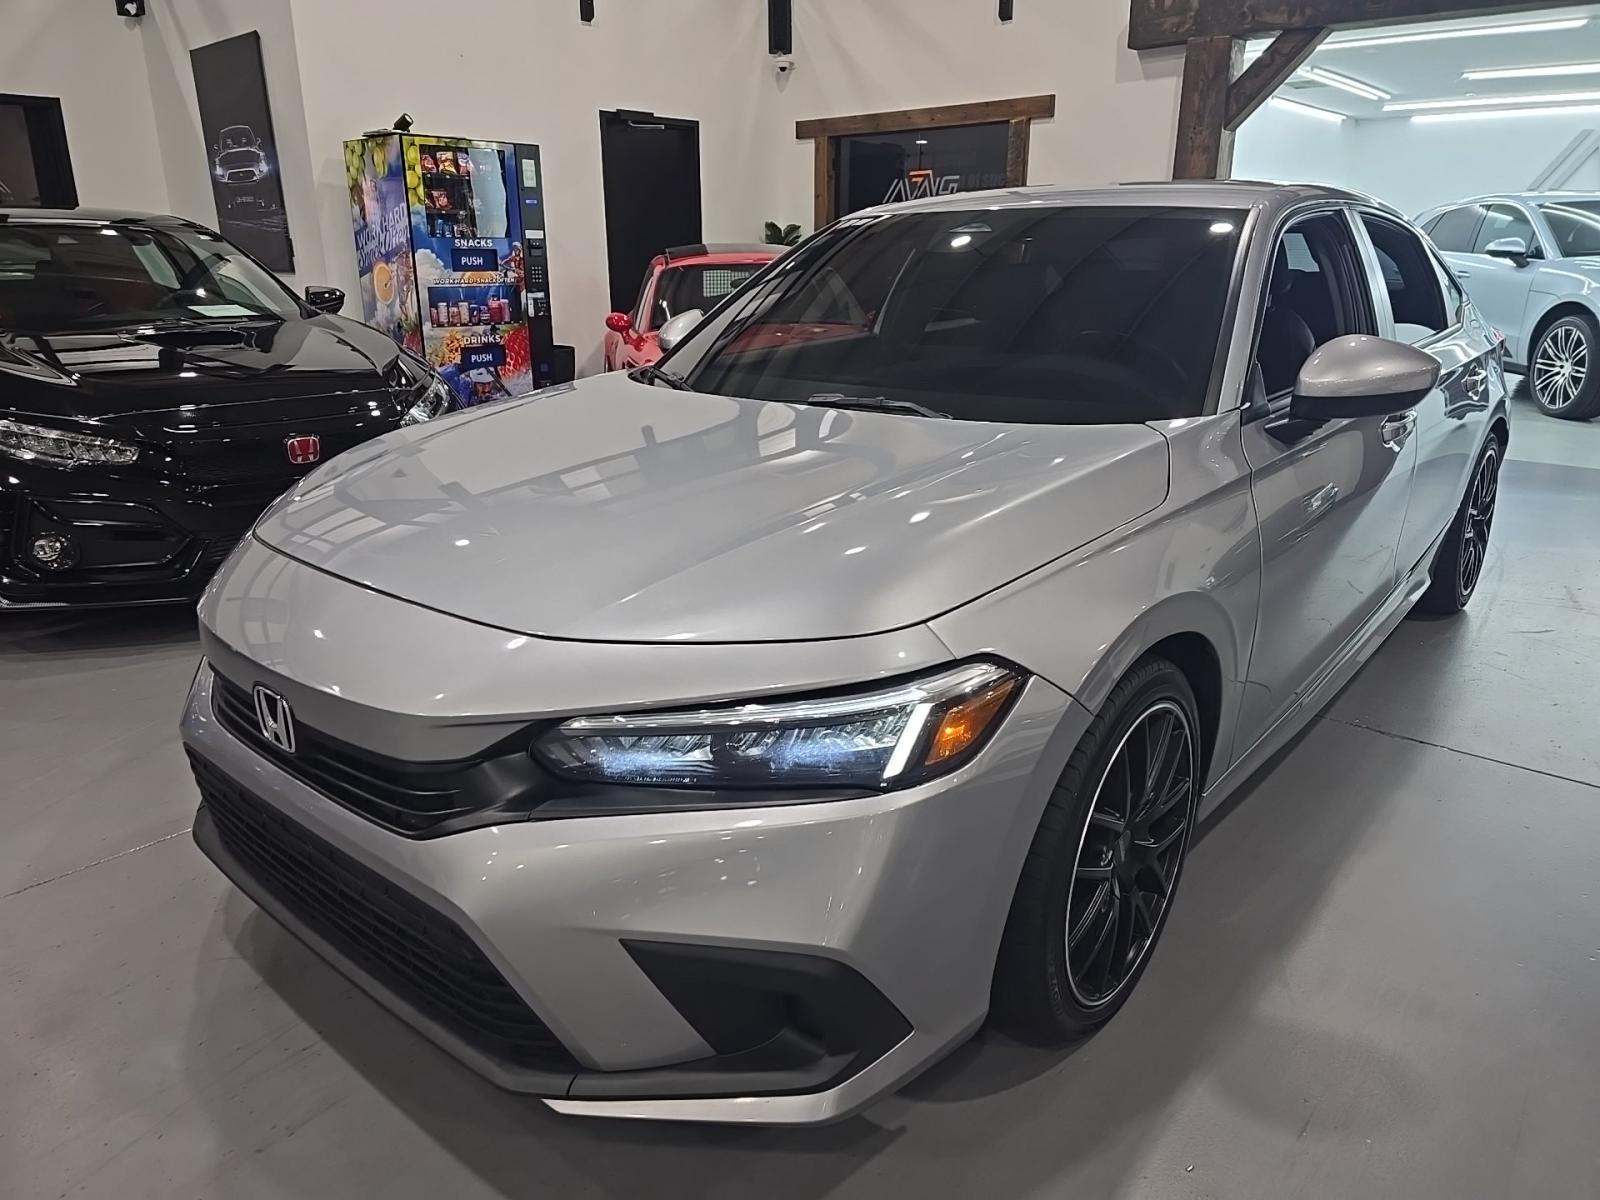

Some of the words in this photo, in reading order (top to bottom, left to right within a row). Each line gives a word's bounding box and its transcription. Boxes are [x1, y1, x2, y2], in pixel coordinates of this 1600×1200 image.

[357, 222, 382, 249] WORK
[382, 202, 407, 232] HARD
[454, 239, 493, 247] SNACKS
[461, 256, 484, 266] PUSH
[464, 334, 501, 344] DRINKS
[471, 353, 493, 363] PUSH
